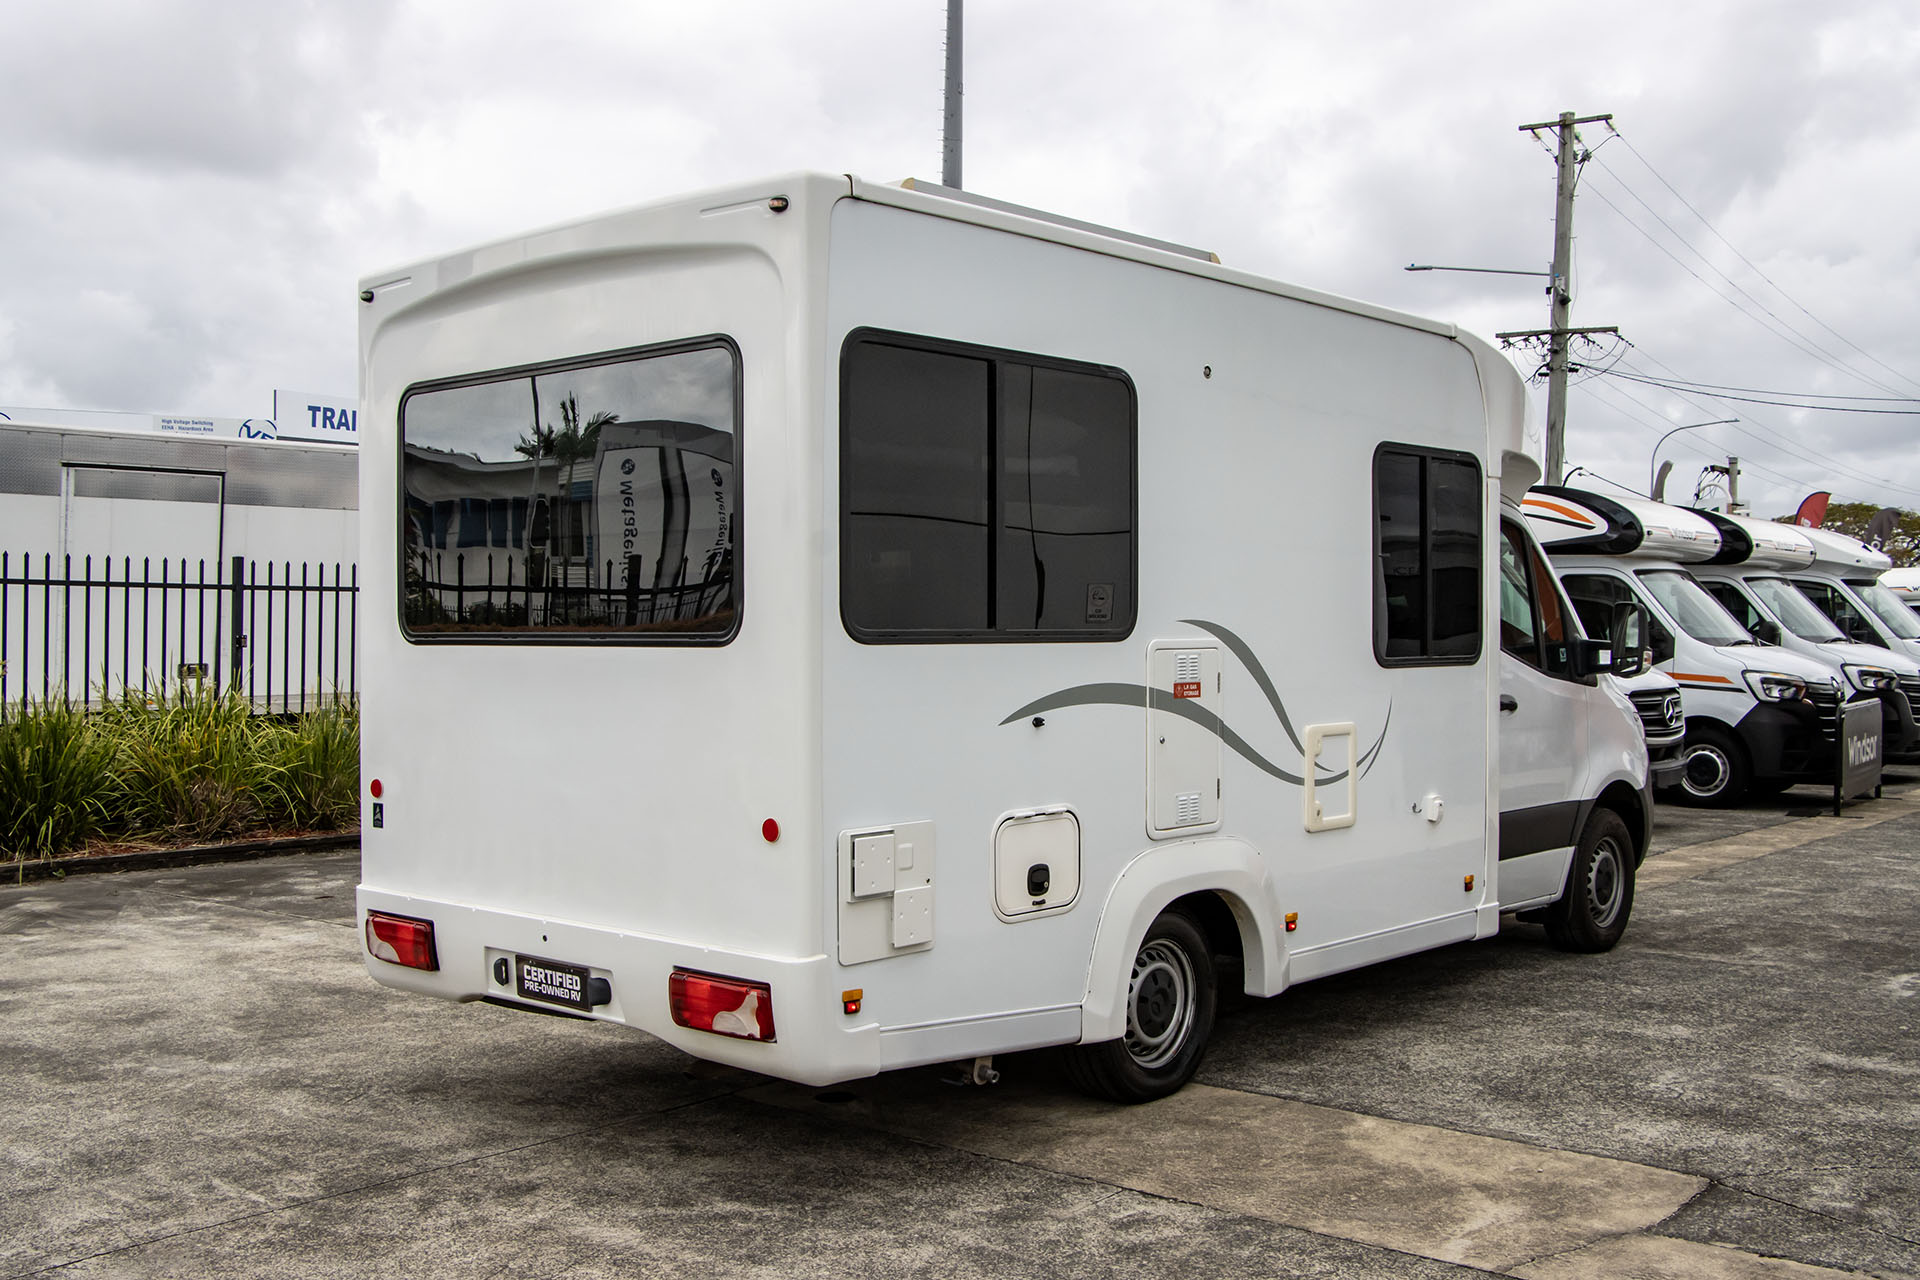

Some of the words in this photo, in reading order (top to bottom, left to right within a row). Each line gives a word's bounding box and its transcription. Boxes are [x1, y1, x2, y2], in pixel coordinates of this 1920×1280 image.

[161, 418, 173, 426] High
[173, 419, 191, 427] Voltage
[191, 419, 214, 428] Switching
[1848, 732, 1877, 767] Windsor
[523, 964, 581, 991] CERTIFIED
[524, 980, 570, 999] PRE-OWNED
[570, 991, 581, 1002] RV
